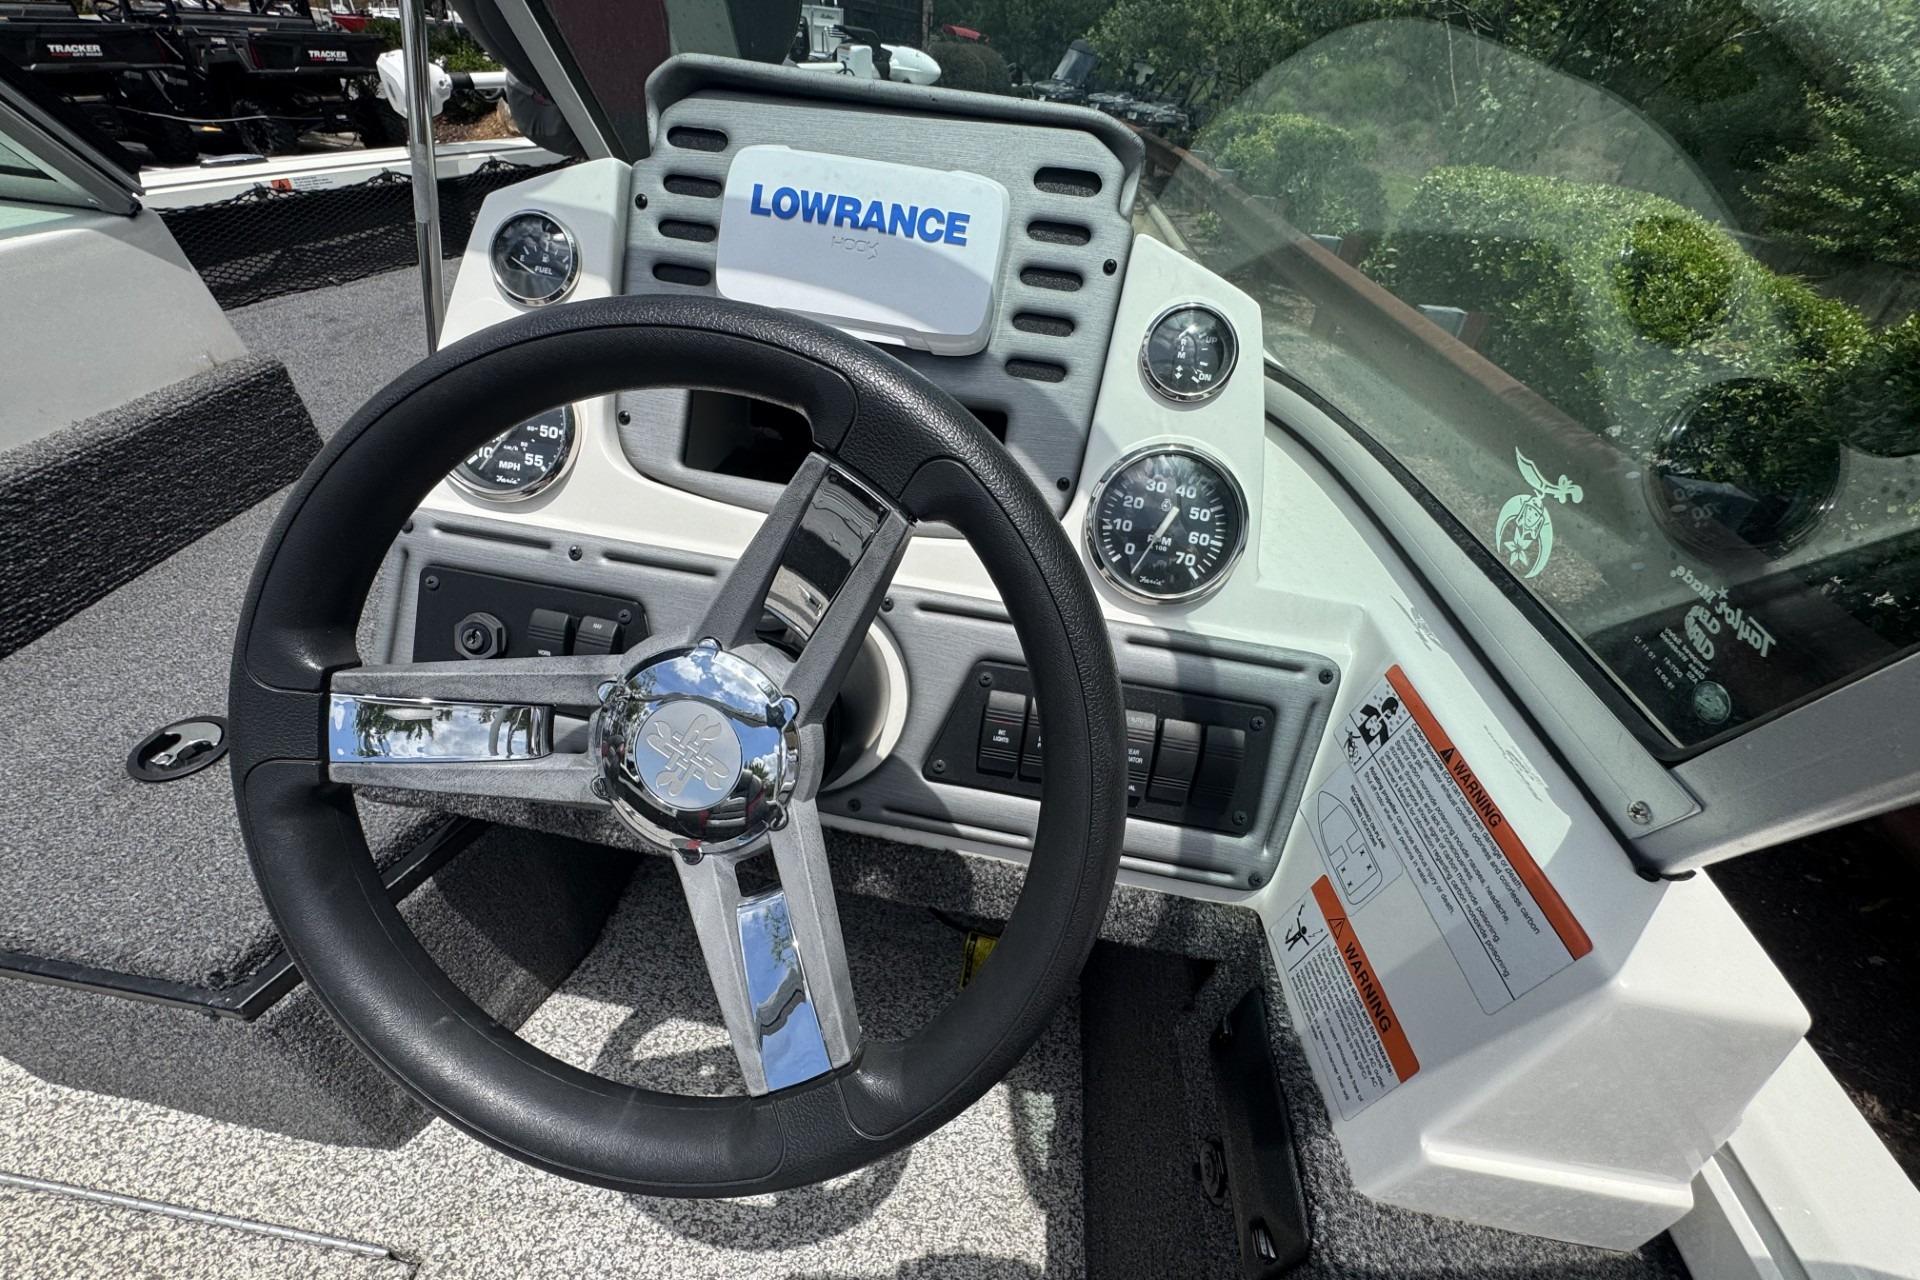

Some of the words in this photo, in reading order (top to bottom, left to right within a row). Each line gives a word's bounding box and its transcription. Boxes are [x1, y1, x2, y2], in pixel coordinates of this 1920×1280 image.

[47, 44, 101, 52] TRACKER
[751, 184, 970, 246] LOWRANCE
[535, 266, 552, 275] FUEL
[1198, 373, 1212, 382] DN
[539, 424, 558, 439] 50
[478, 446, 493, 459] 10
[524, 452, 544, 467] 55
[499, 460, 520, 471] MPH
[1146, 479, 1166, 493] 30
[1176, 485, 1197, 499] 40
[1123, 495, 1144, 509] 20
[1189, 507, 1210, 522] 50
[1113, 518, 1132, 532] 10
[1188, 532, 1210, 546] 60
[1124, 543, 1135, 554] 0
[1176, 552, 1196, 566] 70
[1451, 759, 1503, 828] WARNING
[1410, 722, 1426, 744] Carbon
[1423, 742, 1444, 771] Monoxide
[1441, 769, 1454, 786] (CO)
[1451, 784, 1461, 797] can
[1458, 796, 1473, 816] cause
[1471, 814, 1484, 832] brain
[1480, 831, 1502, 860] damage
[1499, 858, 1508, 868] or
[1504, 866, 1523, 891] death.
[1368, 765, 1384, 790] Rotating
[1380, 788, 1399, 816] propeller
[1395, 814, 1404, 827] can
[1412, 843, 1428, 868] serious
[1423, 800, 1433, 814] and
[1430, 812, 1440, 826] lack
[1438, 824, 1445, 834] of
[1393, 738, 1406, 756] Signs
[1406, 759, 1421, 780] carbon
[1418, 778, 1437, 807] monoxide
[1434, 805, 1455, 836] poisoning
[1453, 833, 1470, 859] include
[1484, 884, 1511, 924] headache,
[1404, 727, 1419, 748] Engine
[1416, 745, 1426, 758] and
[1440, 782, 1457, 807] exhaust
[1454, 805, 1474, 832] contains
[1471, 830, 1493, 860] odorless
[1489, 859, 1502, 875] and
[1498, 873, 1523, 907] colorless
[1519, 906, 1540, 934] carbon
[1403, 785, 1419, 808] anyone
[1438, 840, 1445, 850] of
[1442, 848, 1459, 873] carbon
[1456, 871, 1479, 906] monoxide
[1474, 904, 1502, 944] poisoning.
[1412, 858, 1419, 867] in
[1430, 848, 1453, 881] regarding
[1450, 878, 1467, 903] carbon
[1464, 902, 1488, 939] monoxide
[1483, 938, 1512, 980] poisoning.
[1332, 945, 1339, 956] To
[1336, 954, 1353, 987] minimize
[1350, 986, 1364, 1010] shock
[1361, 1009, 1371, 1026] and
[1368, 1025, 1378, 1040] fire
[1342, 941, 1393, 1033] WARNING
